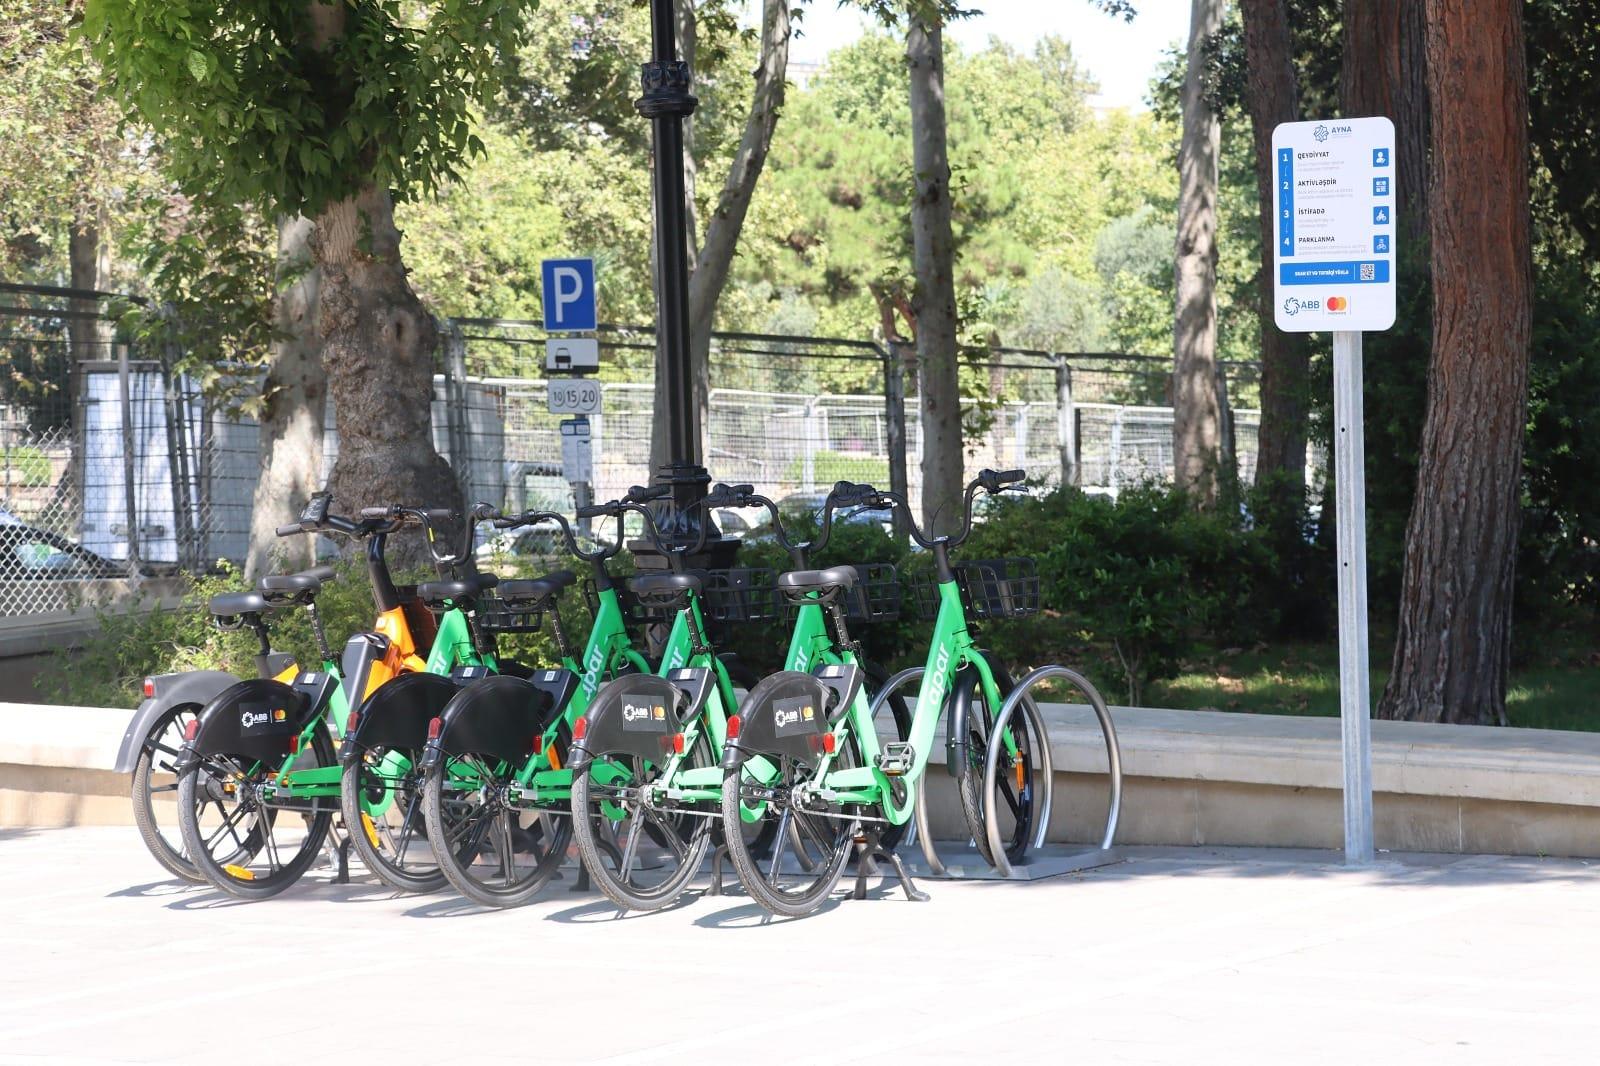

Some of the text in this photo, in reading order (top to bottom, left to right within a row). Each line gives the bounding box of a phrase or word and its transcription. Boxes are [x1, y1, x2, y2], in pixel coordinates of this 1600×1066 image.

[1282, 151, 1330, 162] 1 QEYDİYYAT
[1283, 181, 1289, 190] 2
[1283, 209, 1290, 219] 3
[1283, 236, 1335, 246] 4 PARKLANMA
[553, 267, 583, 323] P
[1300, 300, 1320, 309] ABB
[553, 390, 595, 403] 10 15 20
[794, 645, 808, 672] ar
[928, 641, 950, 705] apar
